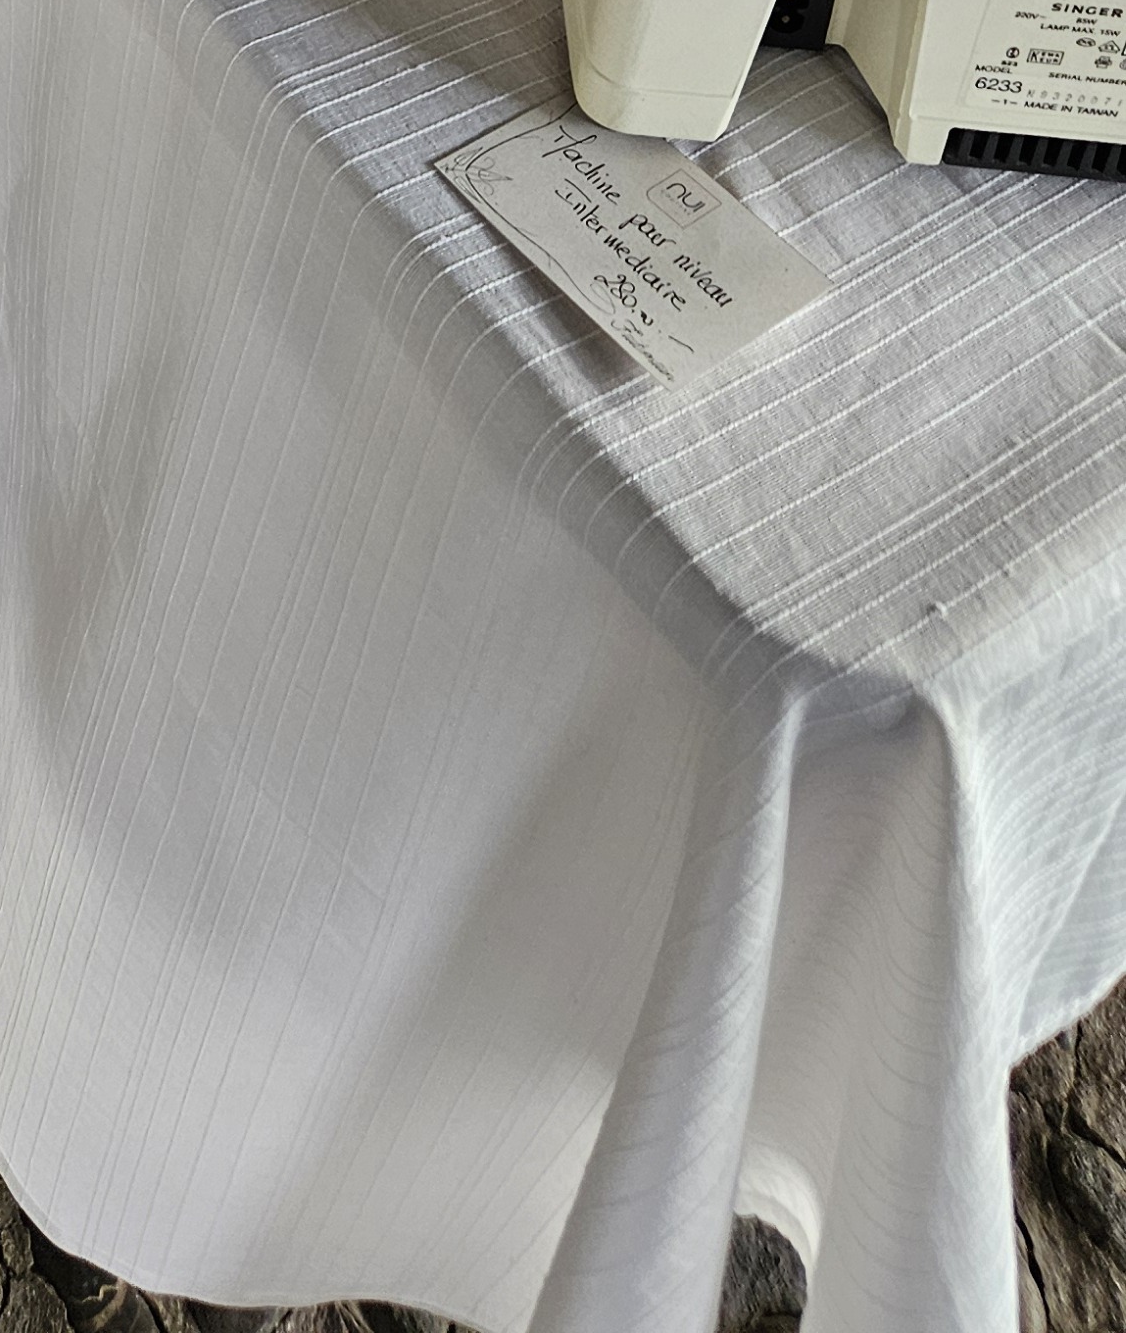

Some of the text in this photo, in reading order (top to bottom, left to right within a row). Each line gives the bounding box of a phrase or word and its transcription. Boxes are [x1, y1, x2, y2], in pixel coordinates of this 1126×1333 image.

[1051, 2, 1124, 18] SINGER
[1040, 22, 1070, 32] LAMP
[975, 64, 1013, 74] MODEL
[1048, 71, 1083, 82] SERIAL
[975, 76, 1023, 94] 6233
[1024, 100, 1058, 112] MADE
[1060, 105, 1073, 113] IN
[1077, 106, 1119, 118] TAIWAN
[673, 253, 734, 309] niveau
